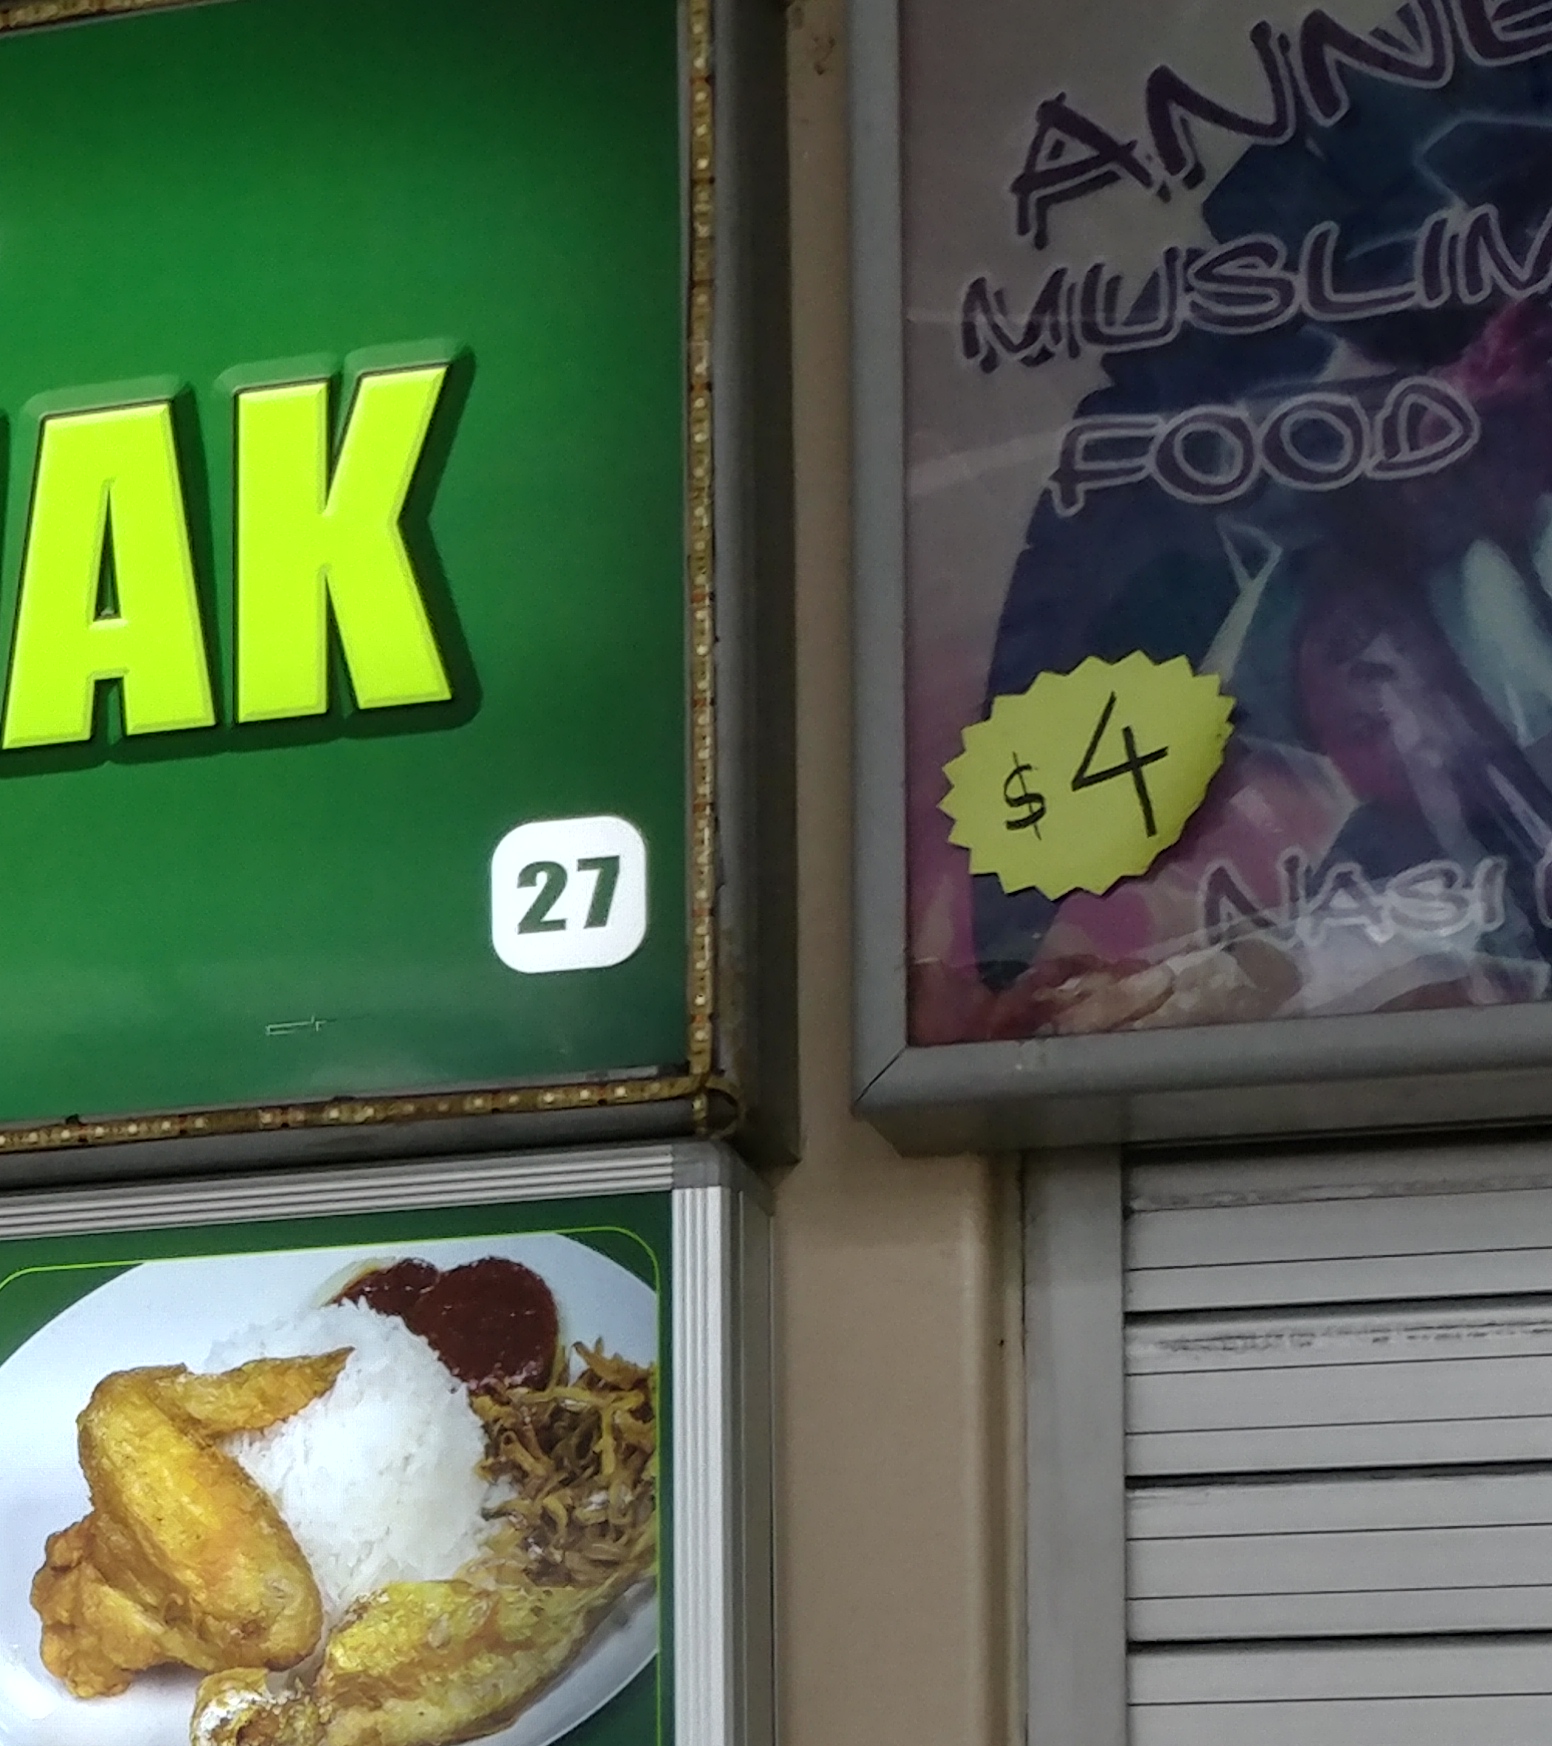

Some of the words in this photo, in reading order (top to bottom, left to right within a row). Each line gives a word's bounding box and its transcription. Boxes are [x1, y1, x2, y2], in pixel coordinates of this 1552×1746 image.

[1048, 374, 1481, 517] FOOD
[515, 853, 622, 937] 27
[1198, 845, 1507, 950] NASI
